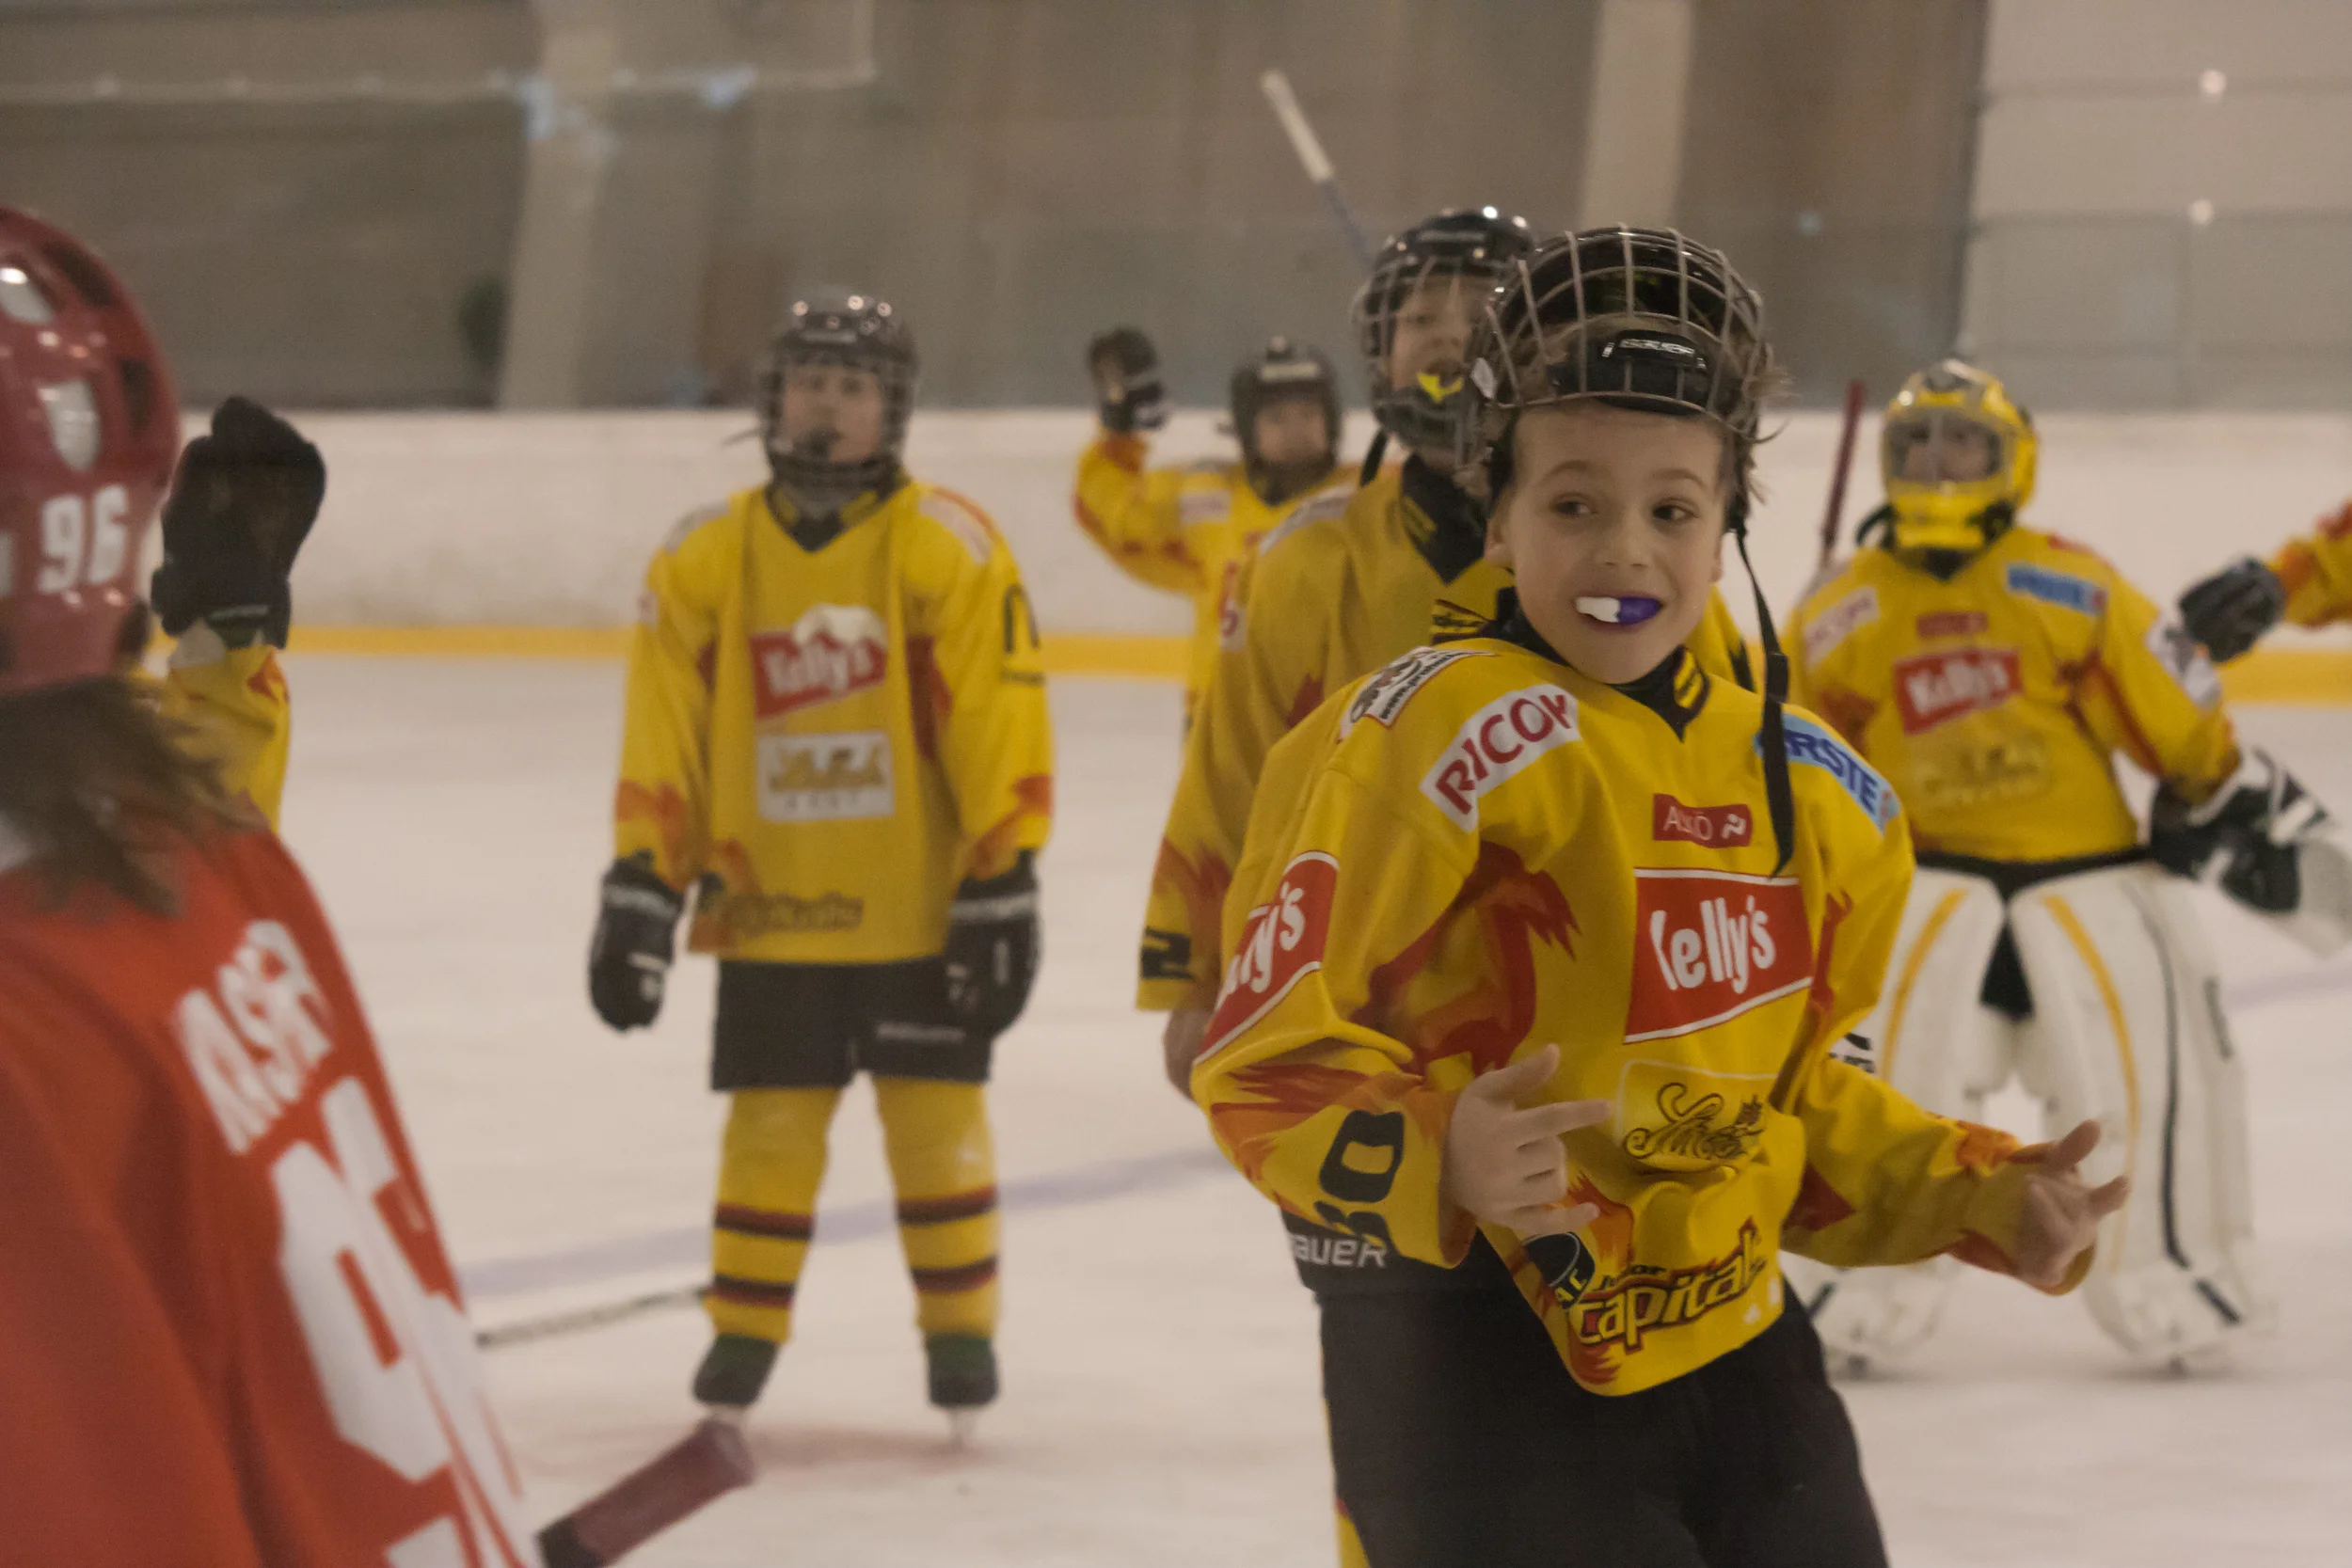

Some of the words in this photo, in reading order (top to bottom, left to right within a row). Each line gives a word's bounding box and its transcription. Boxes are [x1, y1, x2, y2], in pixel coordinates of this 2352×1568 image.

[40, 484, 129, 593] 96
[1785, 729, 1878, 816] RSTE
[1292, 1234, 1388, 1268] AUER
